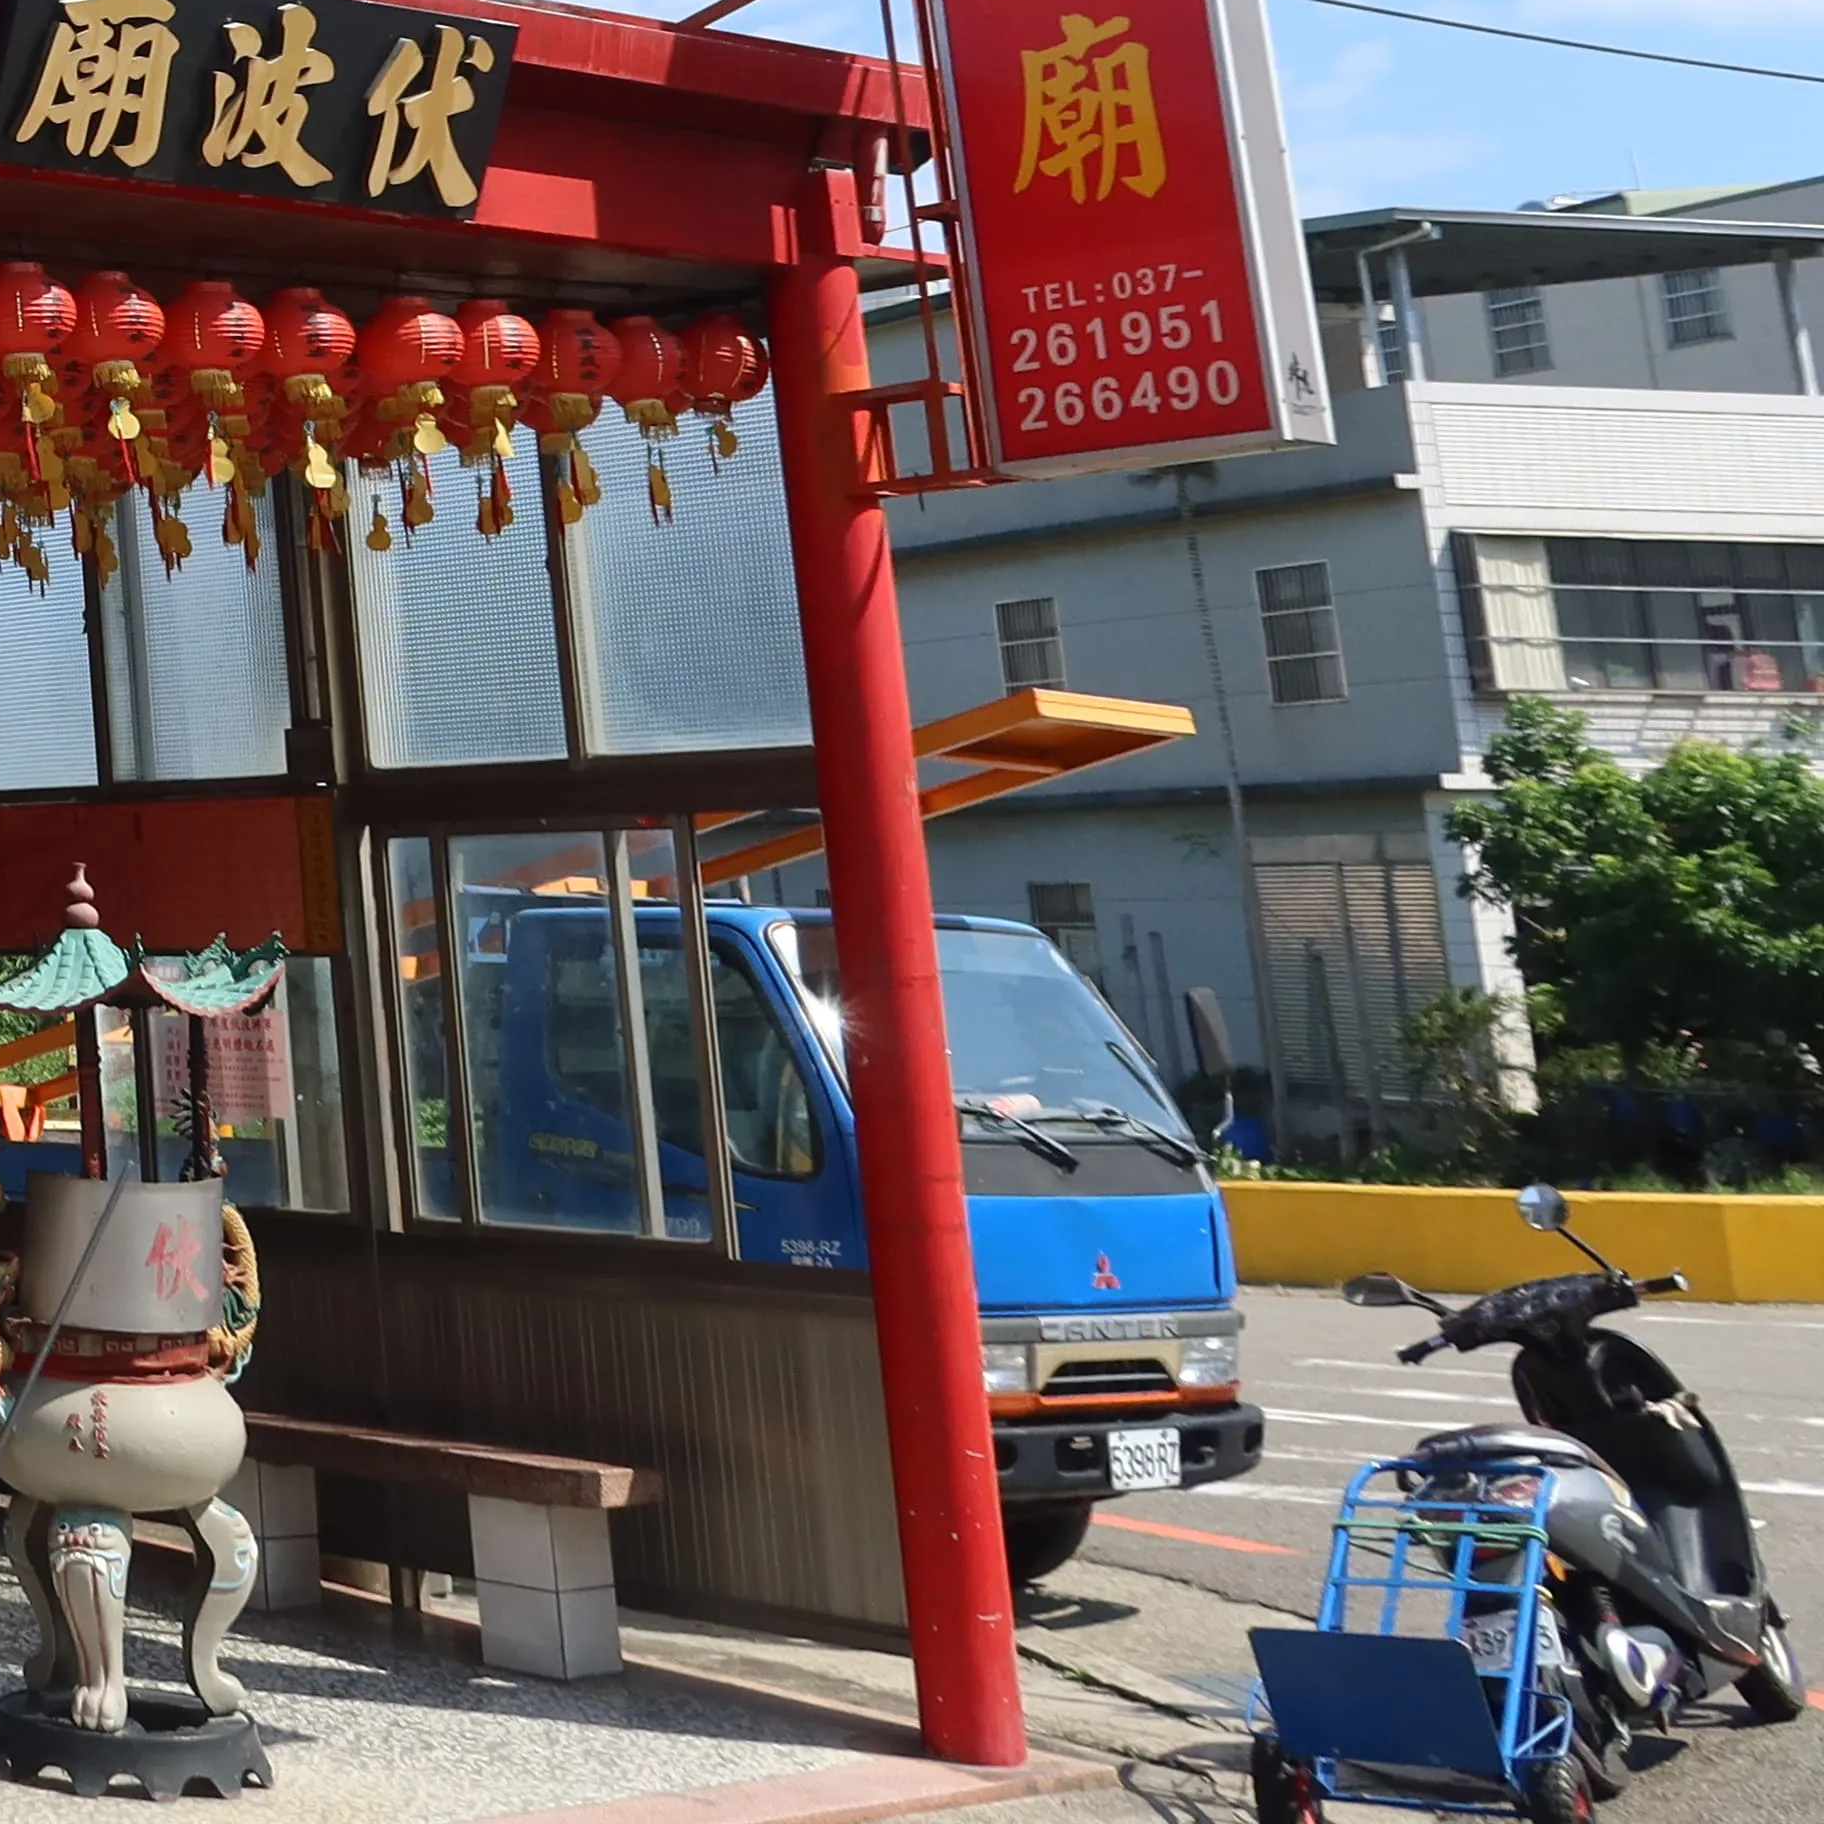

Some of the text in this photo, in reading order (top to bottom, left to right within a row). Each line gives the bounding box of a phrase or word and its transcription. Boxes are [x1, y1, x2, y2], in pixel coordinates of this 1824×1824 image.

[1012, 14, 1168, 203] 廟
[1021, 263, 1204, 314] TEL:037-
[1009, 298, 1225, 373] 261951
[1016, 360, 1240, 432] 266490
[1039, 1314, 1181, 1343] CANTER
